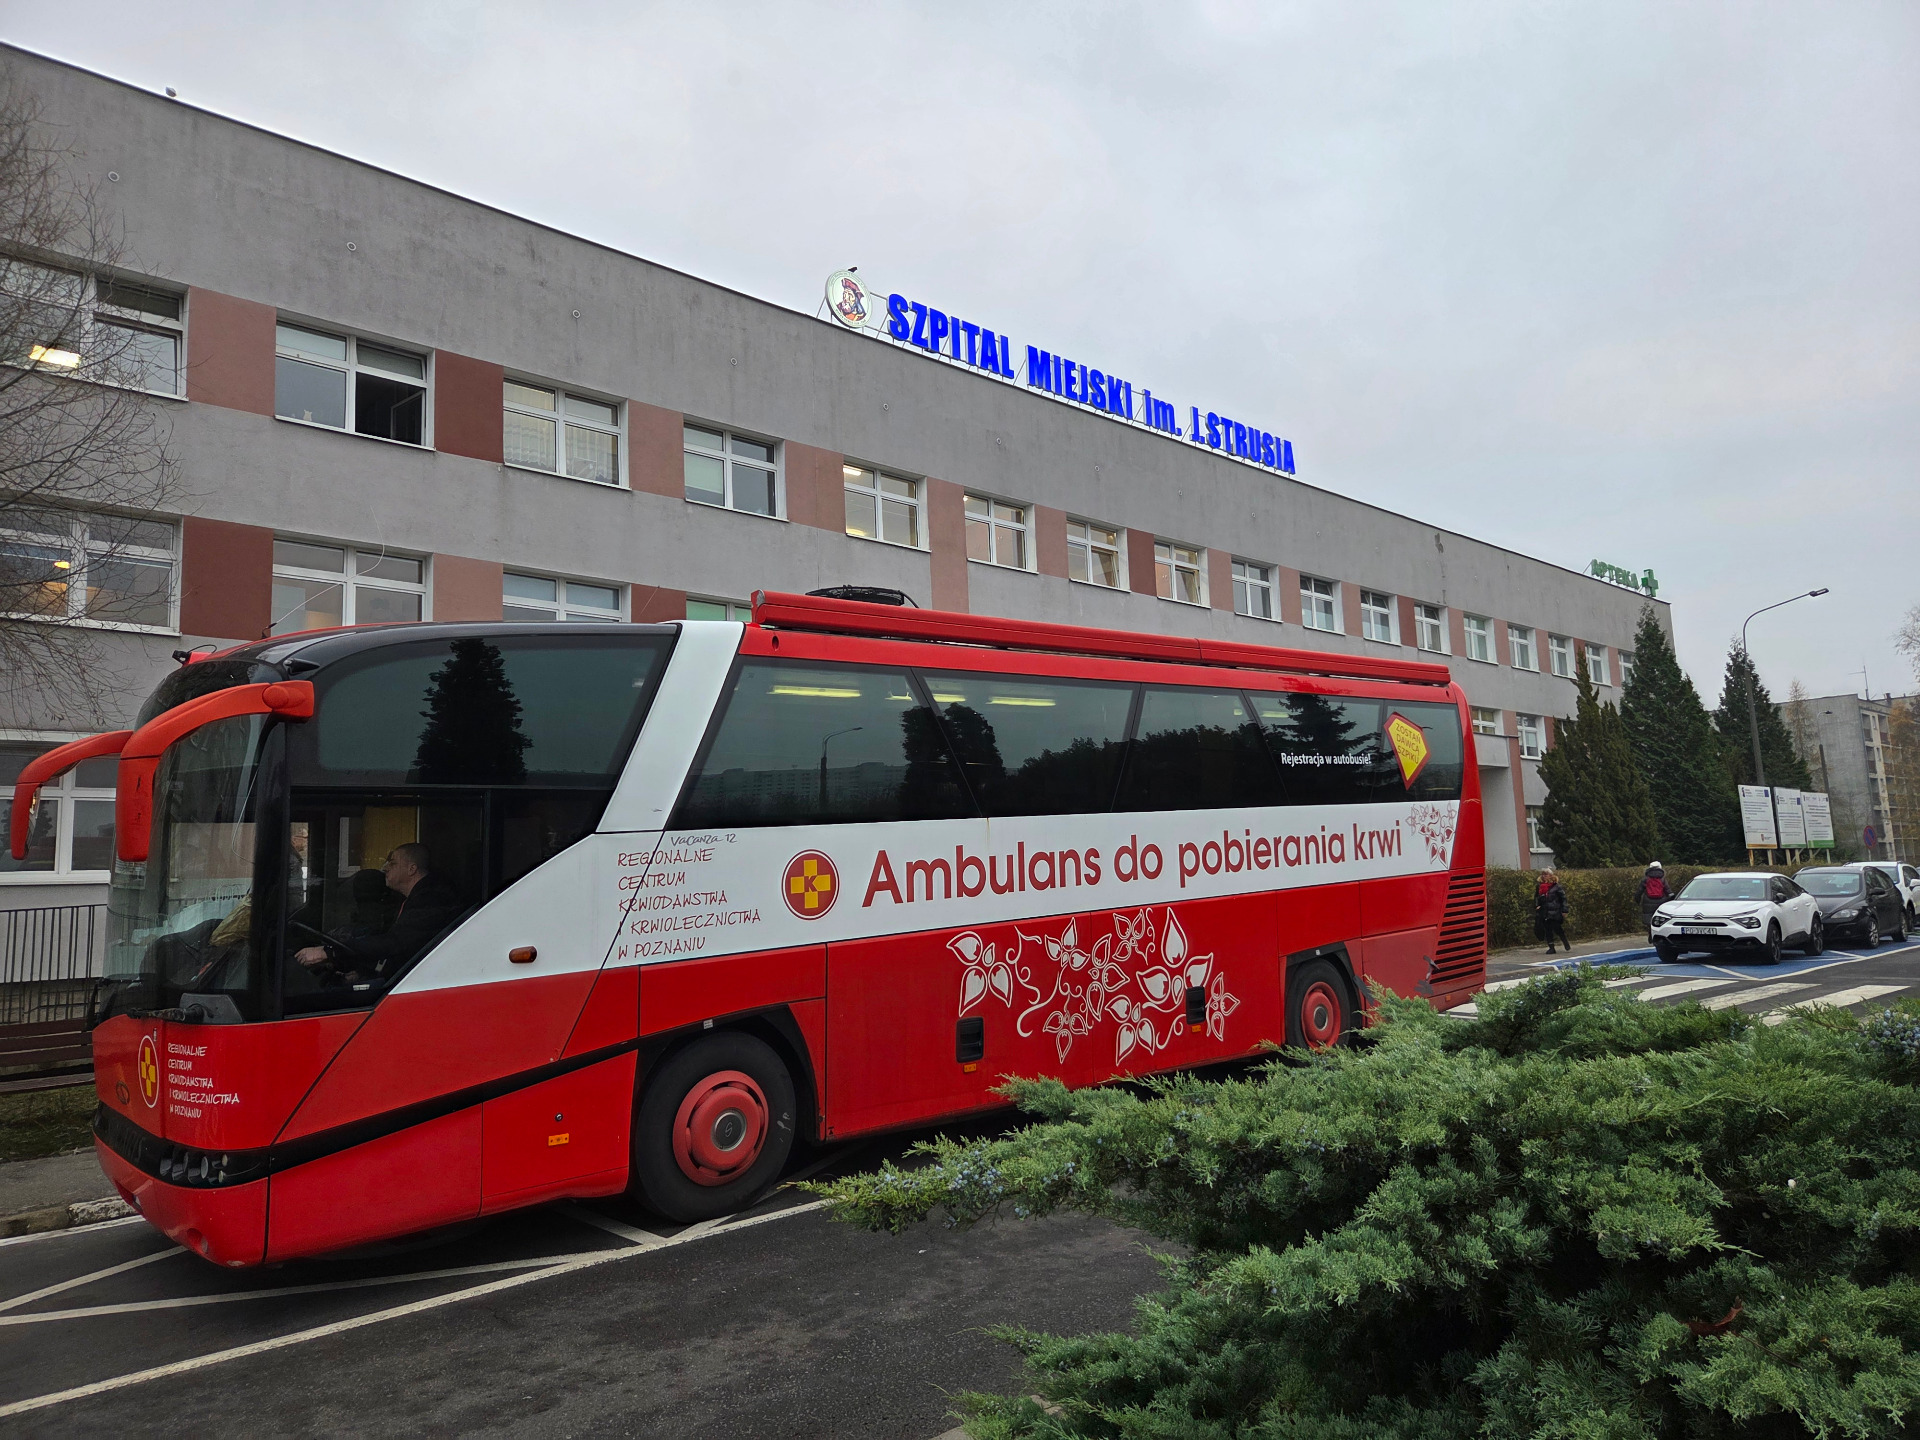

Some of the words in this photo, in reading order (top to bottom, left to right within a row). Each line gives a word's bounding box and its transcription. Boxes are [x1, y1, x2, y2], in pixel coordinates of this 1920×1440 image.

[886, 293, 1015, 379] SZPITAL
[1024, 344, 1133, 421] MIEJSKI
[1141, 389, 1182, 437] im.
[1591, 559, 1639, 590] APTEKA
[1395, 722, 1421, 744] ZOSTAŃ
[1396, 733, 1420, 756] DAWCĄ
[1397, 745, 1419, 764] SZPIKU
[1281, 752, 1324, 767] Rejestracja
[1325, 755, 1333, 764] w
[1333, 753, 1372, 765] autobusie!
[617, 848, 715, 867] REGIONALNE
[862, 838, 1101, 908] Ambulans
[1113, 834, 1164, 882] do
[1178, 824, 1346, 888] pobierania
[1353, 819, 1402, 861] krwi
[618, 871, 686, 891] CENTRUM
[804, 875, 816, 892] K
[618, 890, 728, 913] KRWIODAWSTWA
[630, 908, 761, 936] KRWIOLECZNICTWA
[618, 944, 628, 960] W
[634, 936, 706, 958] POZNANIU
[168, 1043, 207, 1056] REGIONALNE
[168, 1059, 192, 1071] CENTRUM
[168, 1074, 213, 1088] KRWIODAWSTWA
[169, 1104, 174, 1114] W
[174, 1105, 202, 1118] POZNANIU
